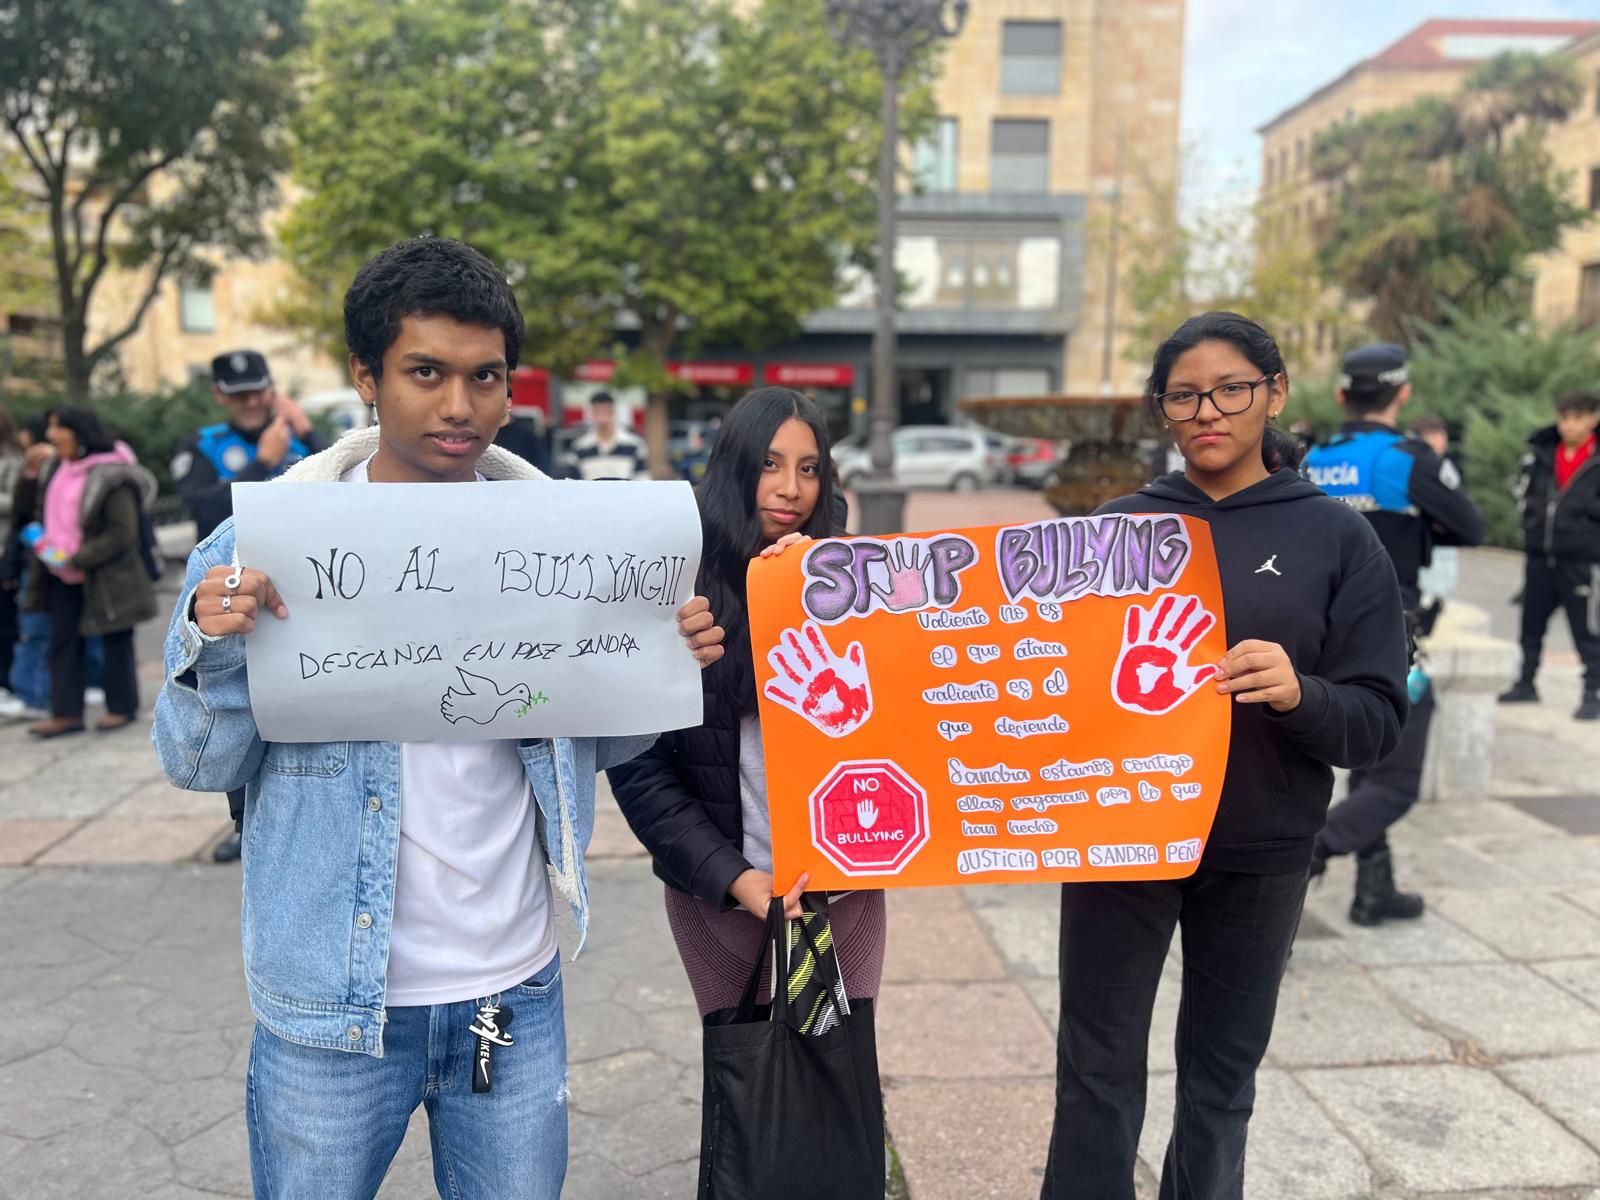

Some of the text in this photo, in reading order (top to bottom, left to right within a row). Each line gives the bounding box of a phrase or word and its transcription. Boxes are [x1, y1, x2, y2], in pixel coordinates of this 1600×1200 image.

[999, 517, 1189, 600] BULLYING
[307, 545, 686, 606] NO AL BULLYING!!!
[918, 603, 1061, 629] Valiente no es
[299, 633, 641, 679] DESCANSA EN PAZ SANDRA
[932, 639, 1065, 666] el que ataca
[924, 670, 1065, 702] valiente es el
[939, 716, 1067, 740] que defiende
[949, 756, 1192, 784] Sandra estamos contigo
[853, 778, 880, 794] NO
[958, 796, 1003, 812] ellas
[1099, 789, 1131, 805] por
[1139, 781, 1160, 801] lo
[1172, 783, 1200, 800] que
[837, 830, 905, 845] BULLYING
[962, 820, 1057, 835] han hecho
[1043, 851, 1079, 866] POR
[1090, 846, 1158, 866] SANDRA
